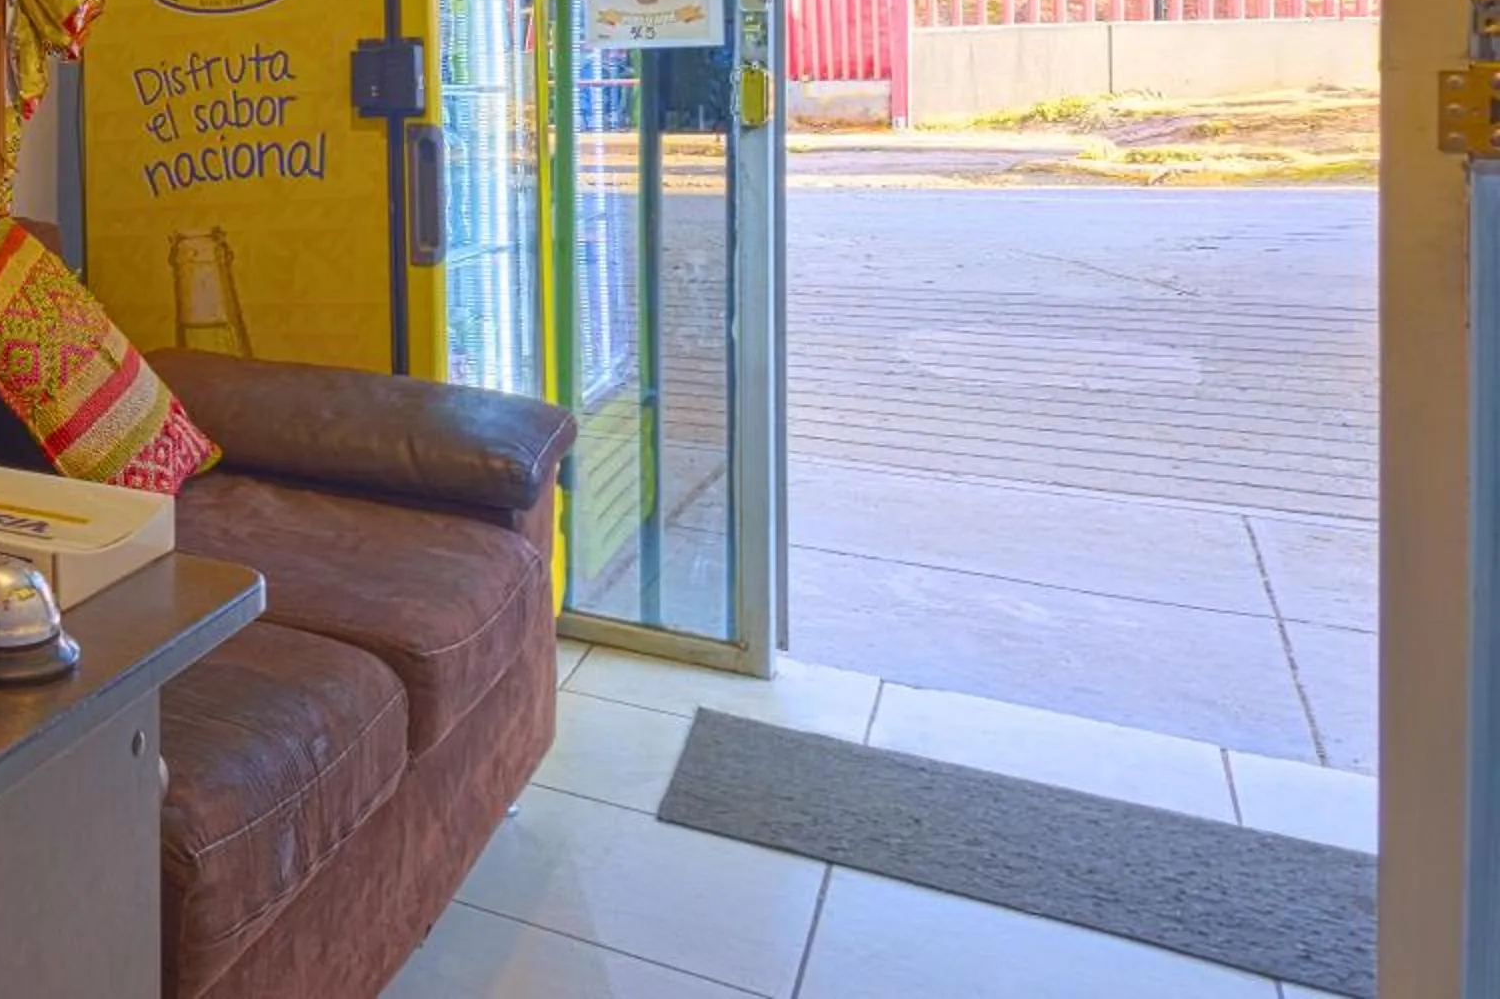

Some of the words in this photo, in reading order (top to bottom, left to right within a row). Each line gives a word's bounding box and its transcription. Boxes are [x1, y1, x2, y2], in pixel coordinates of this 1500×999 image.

[132, 43, 298, 106] Disfruta
[145, 103, 180, 143] el
[194, 90, 299, 134] sabor
[143, 131, 327, 198] nacional
